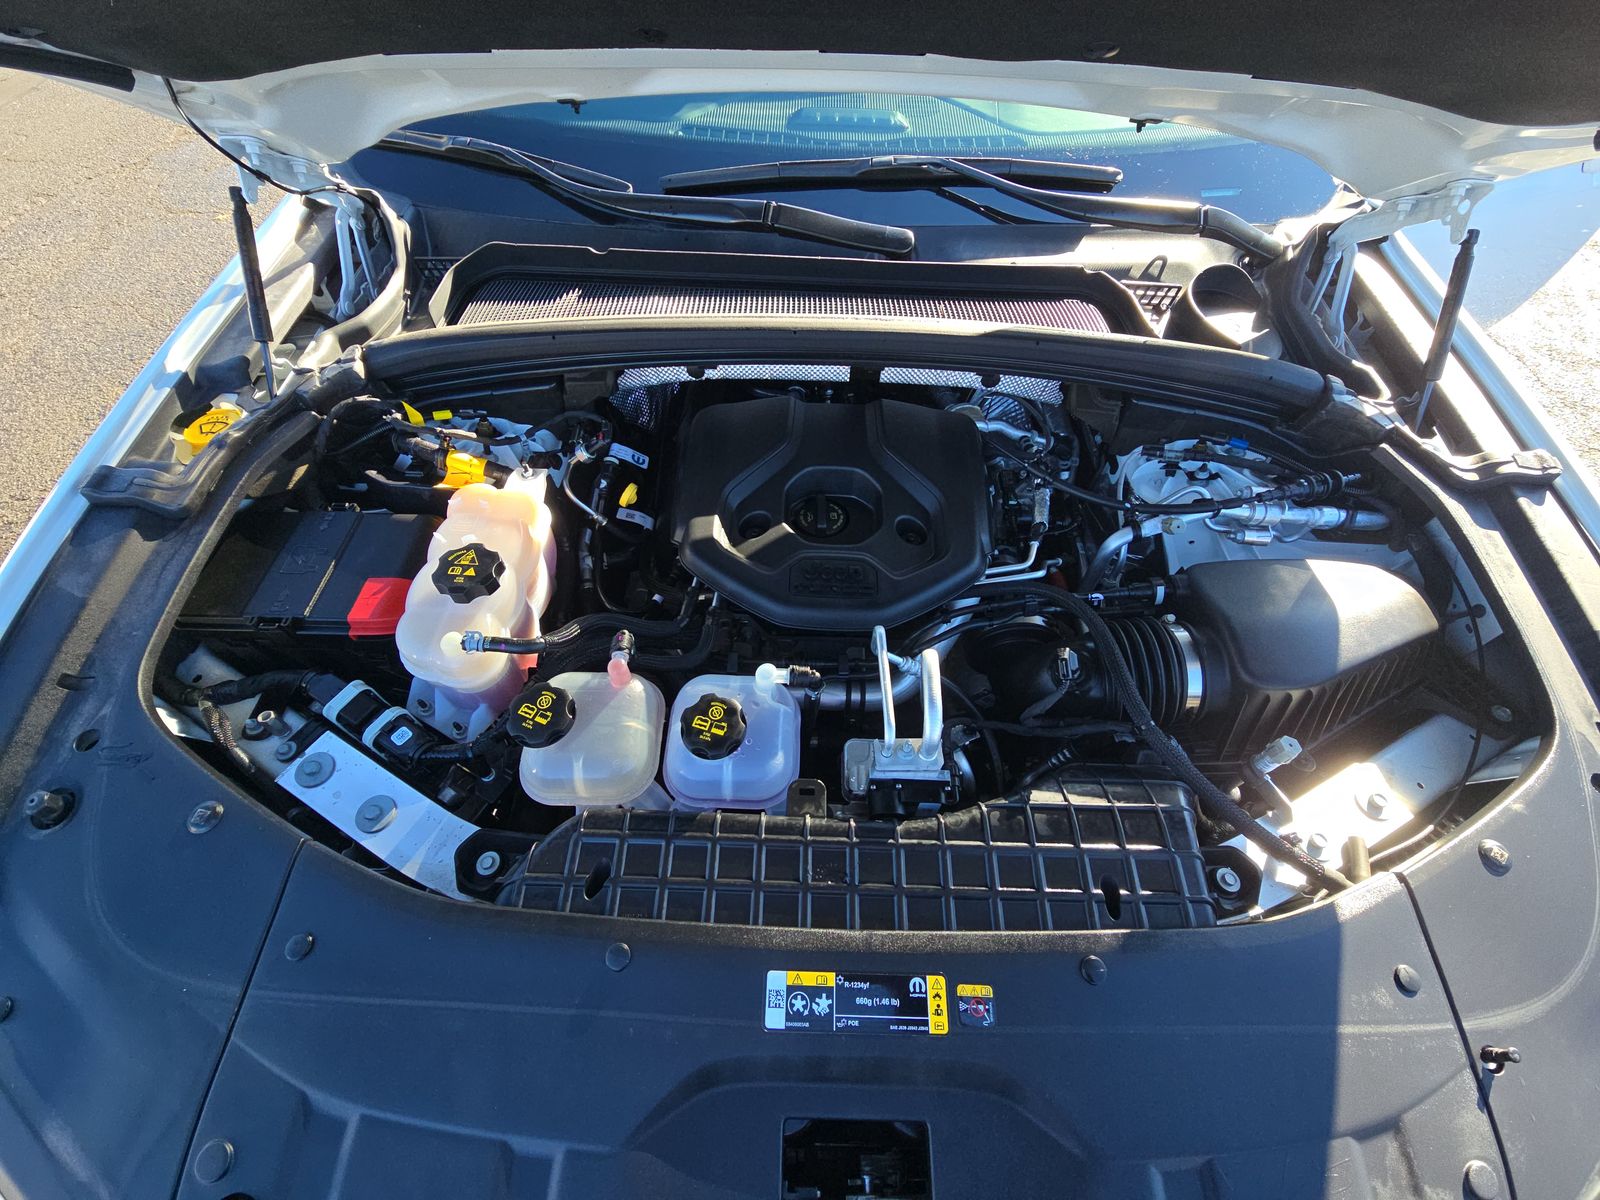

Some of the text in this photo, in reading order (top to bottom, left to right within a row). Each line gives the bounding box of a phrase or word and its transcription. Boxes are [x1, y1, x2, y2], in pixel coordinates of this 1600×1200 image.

[844, 981, 870, 989] R-1234yf
[855, 997, 900, 1007] 660g (1.46 lb)
